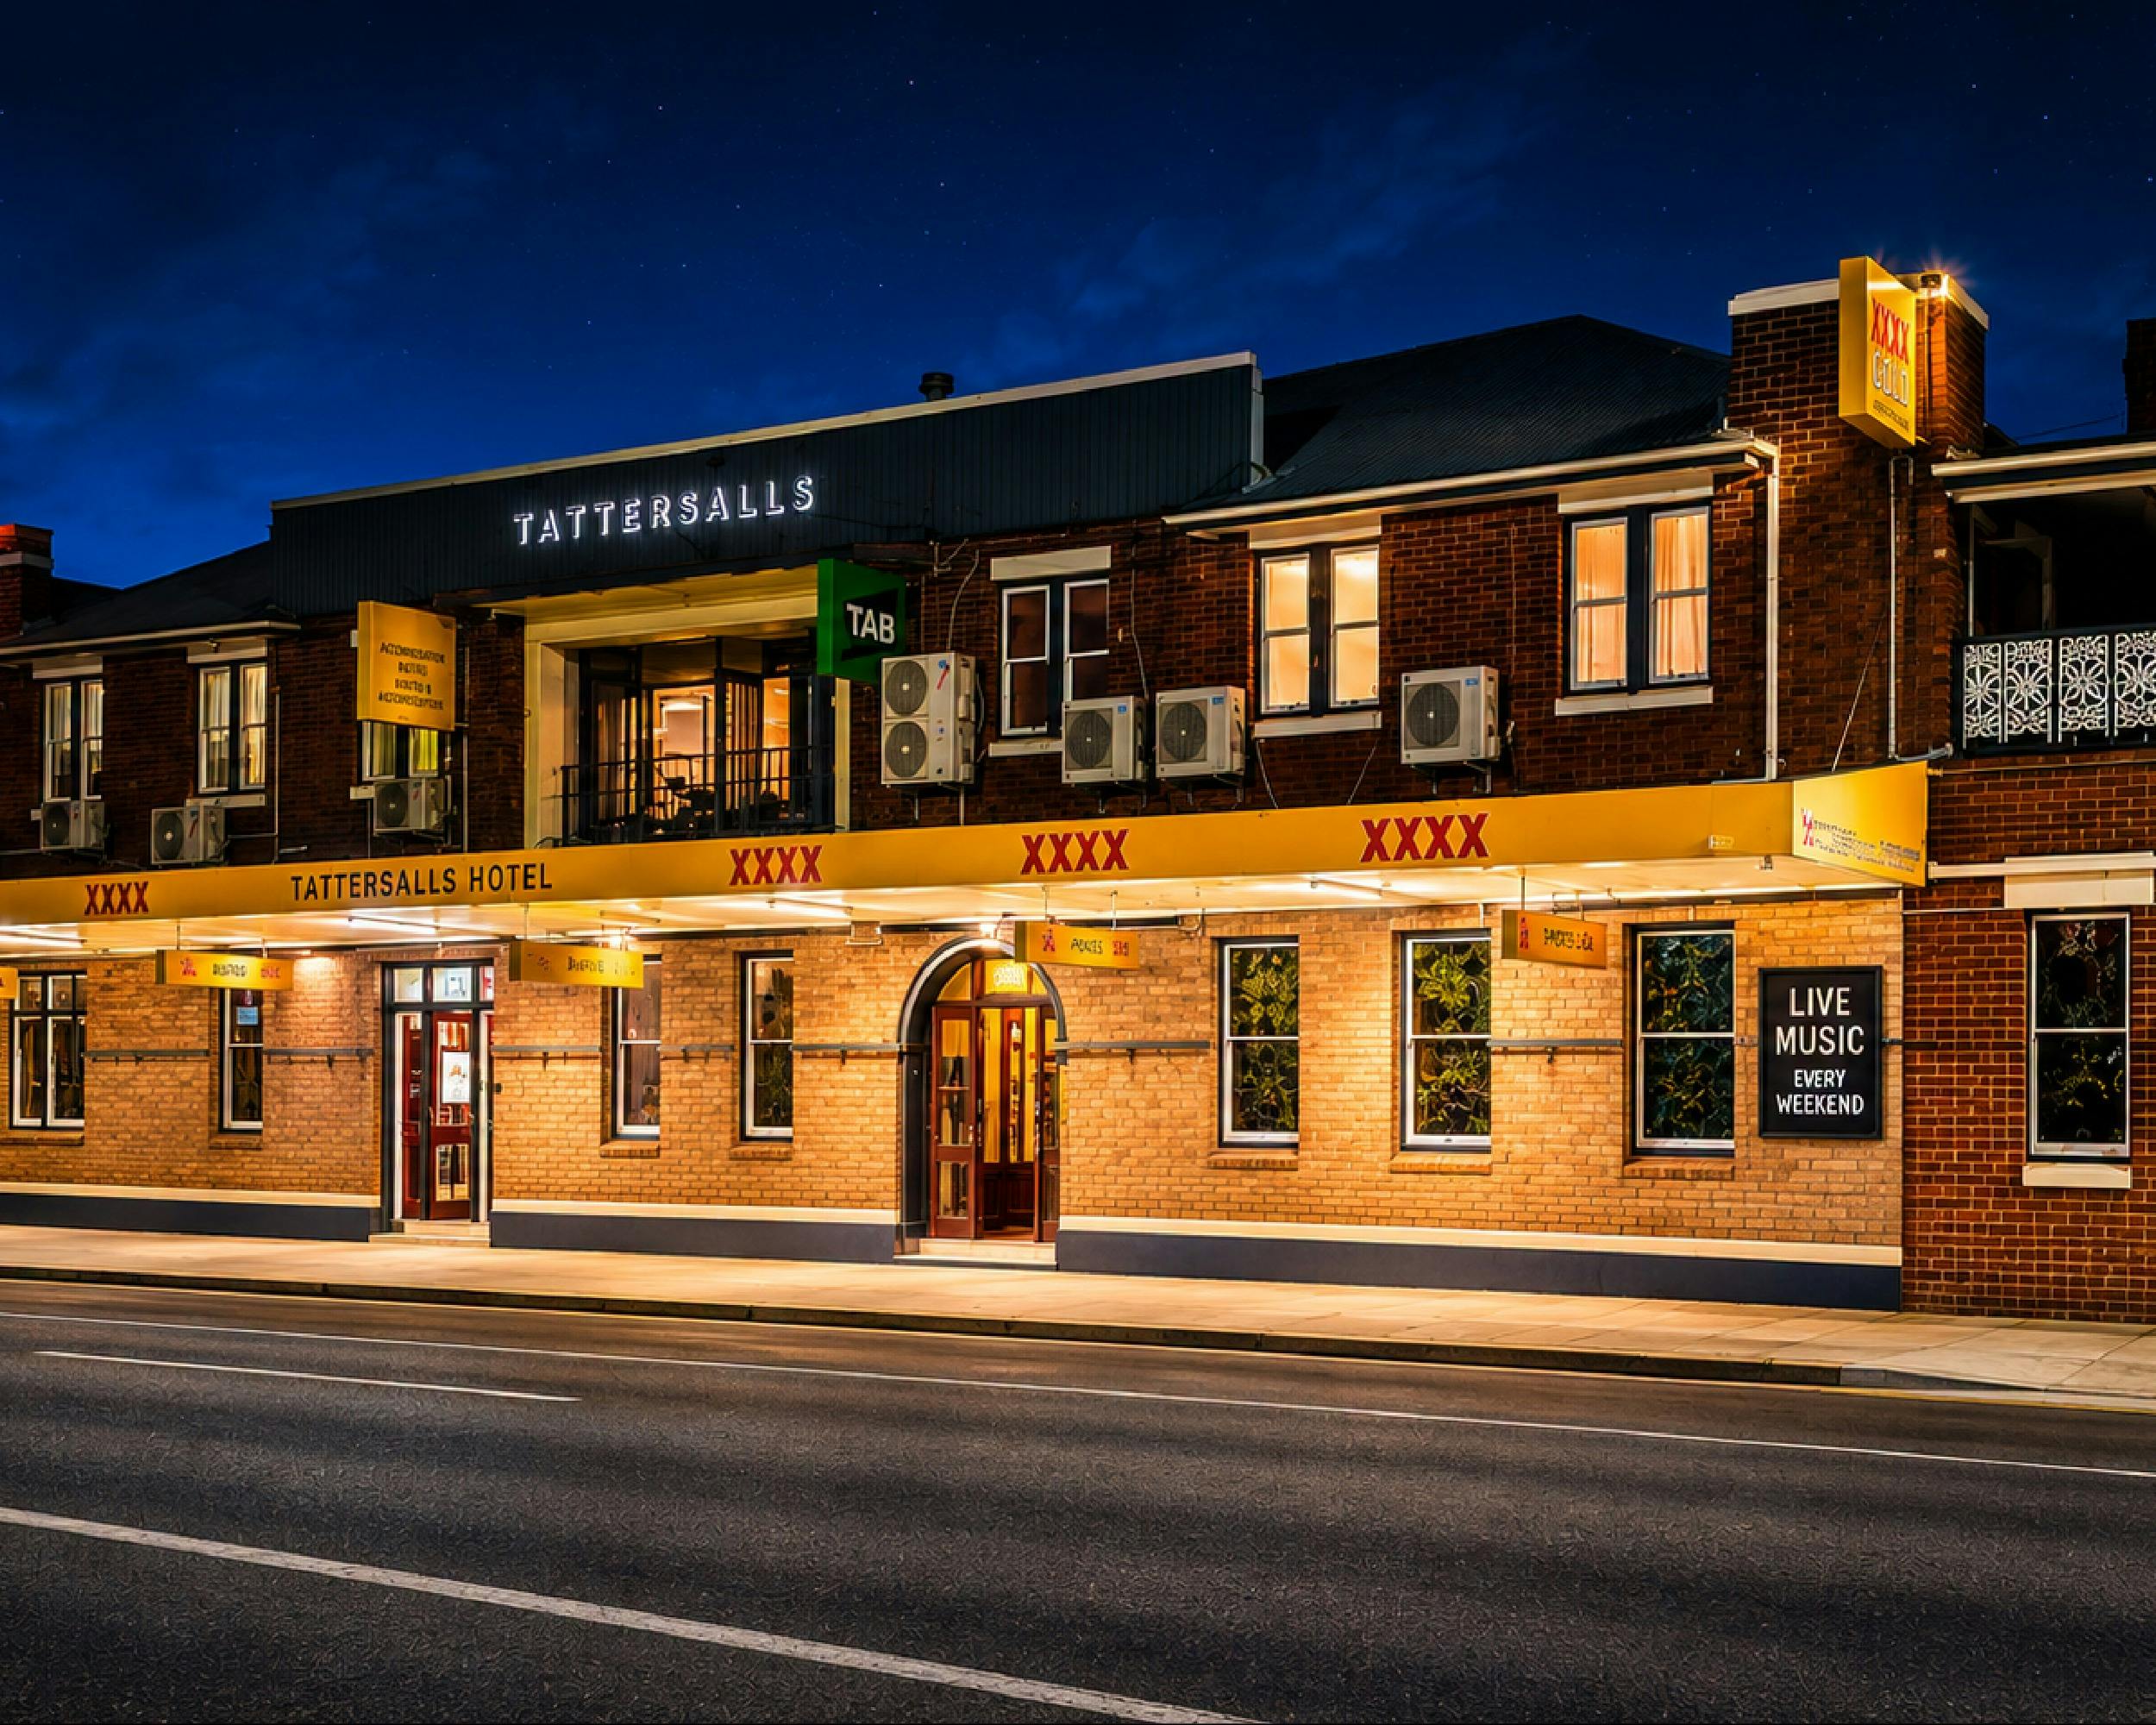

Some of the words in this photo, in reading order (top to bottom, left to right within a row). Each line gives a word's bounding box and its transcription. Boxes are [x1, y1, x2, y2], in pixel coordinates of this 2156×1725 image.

[1871, 297, 1909, 366] XXXX
[513, 475, 814, 545] TATTERSALLS
[846, 603, 895, 644] TAB
[1020, 828, 1130, 875] XXXX
[1360, 813, 1489, 862] XXXX
[291, 868, 456, 901] TATTERSALLS
[469, 862, 553, 893] HOTEL
[729, 844, 823, 887] XXXX
[85, 881, 149, 916] XXXX
[1789, 987, 1852, 1017] LIVE
[1775, 1025, 1865, 1056] MUSIC
[1793, 1068, 1846, 1088] EVERY
[1775, 1093, 1865, 1115] WEEKEND
